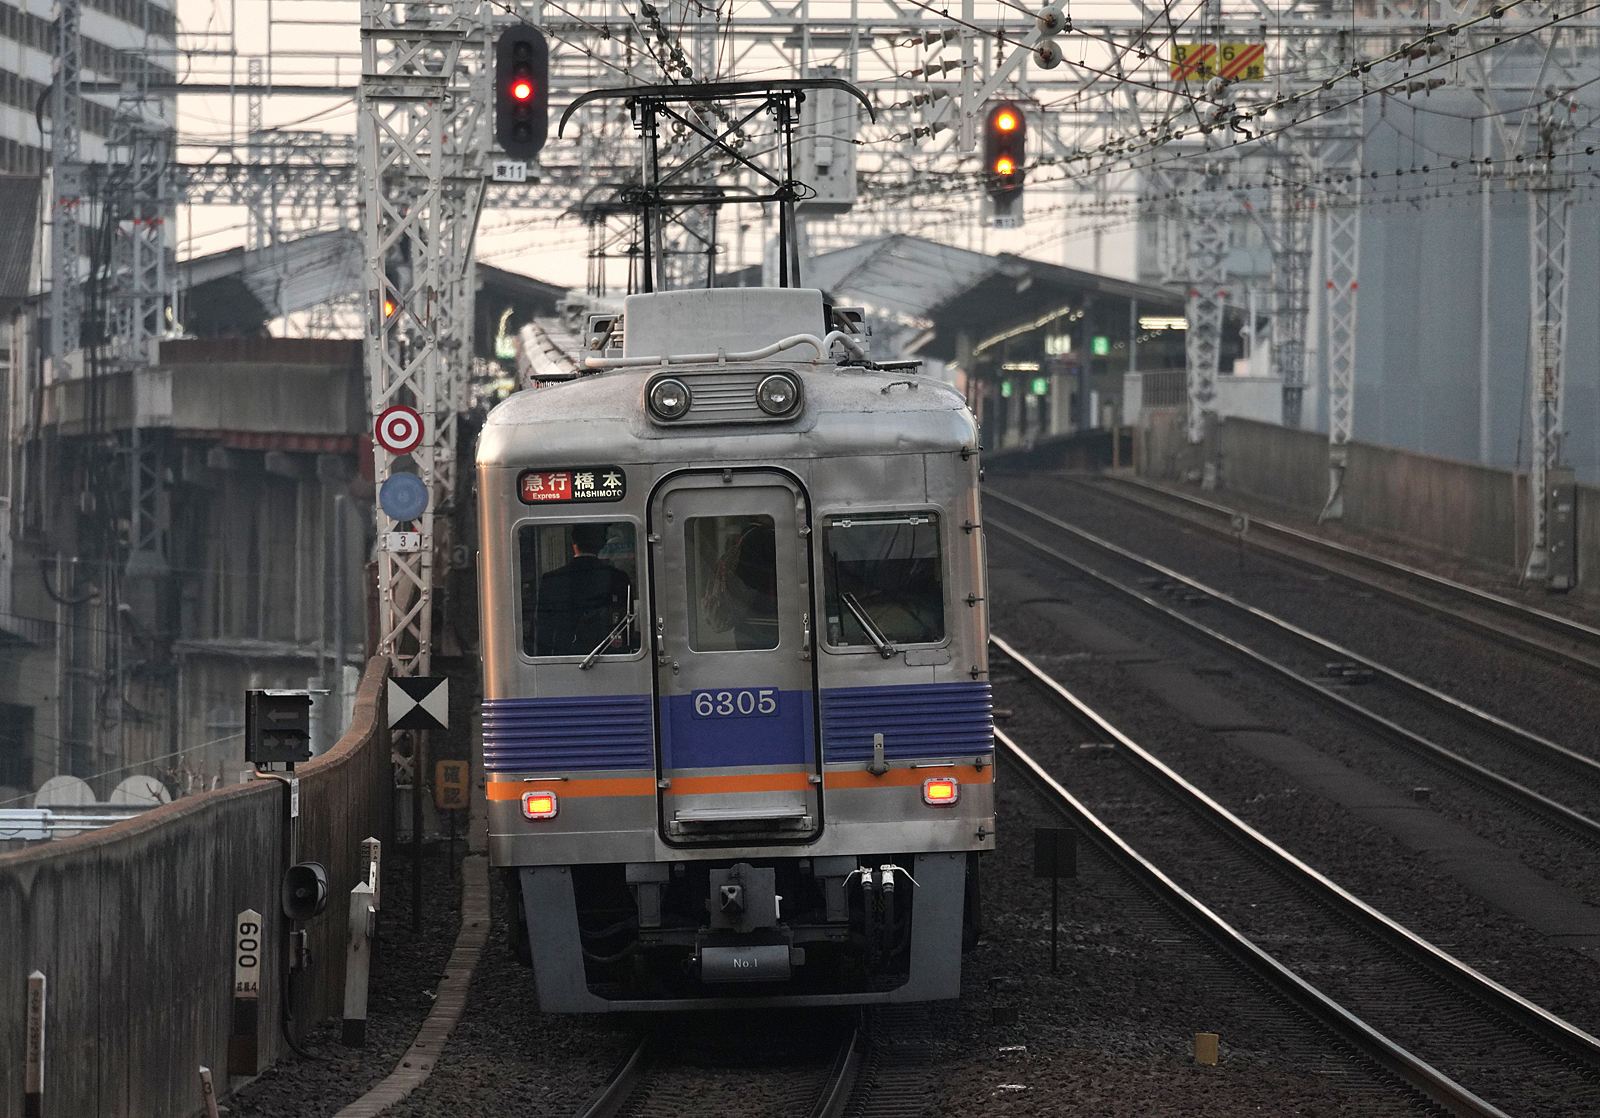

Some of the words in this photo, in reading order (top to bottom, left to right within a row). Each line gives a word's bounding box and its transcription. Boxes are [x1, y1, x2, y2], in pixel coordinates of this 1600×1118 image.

[1222, 46, 1235, 61] 6
[496, 165, 522, 179] 東11
[524, 473, 568, 492] 急行
[574, 471, 622, 490] 橋本
[532, 492, 561, 500] Express
[574, 490, 623, 498] HASHIMOTO
[400, 535, 407, 547] 3
[695, 690, 776, 716] 6305
[443, 765, 461, 804] 確認
